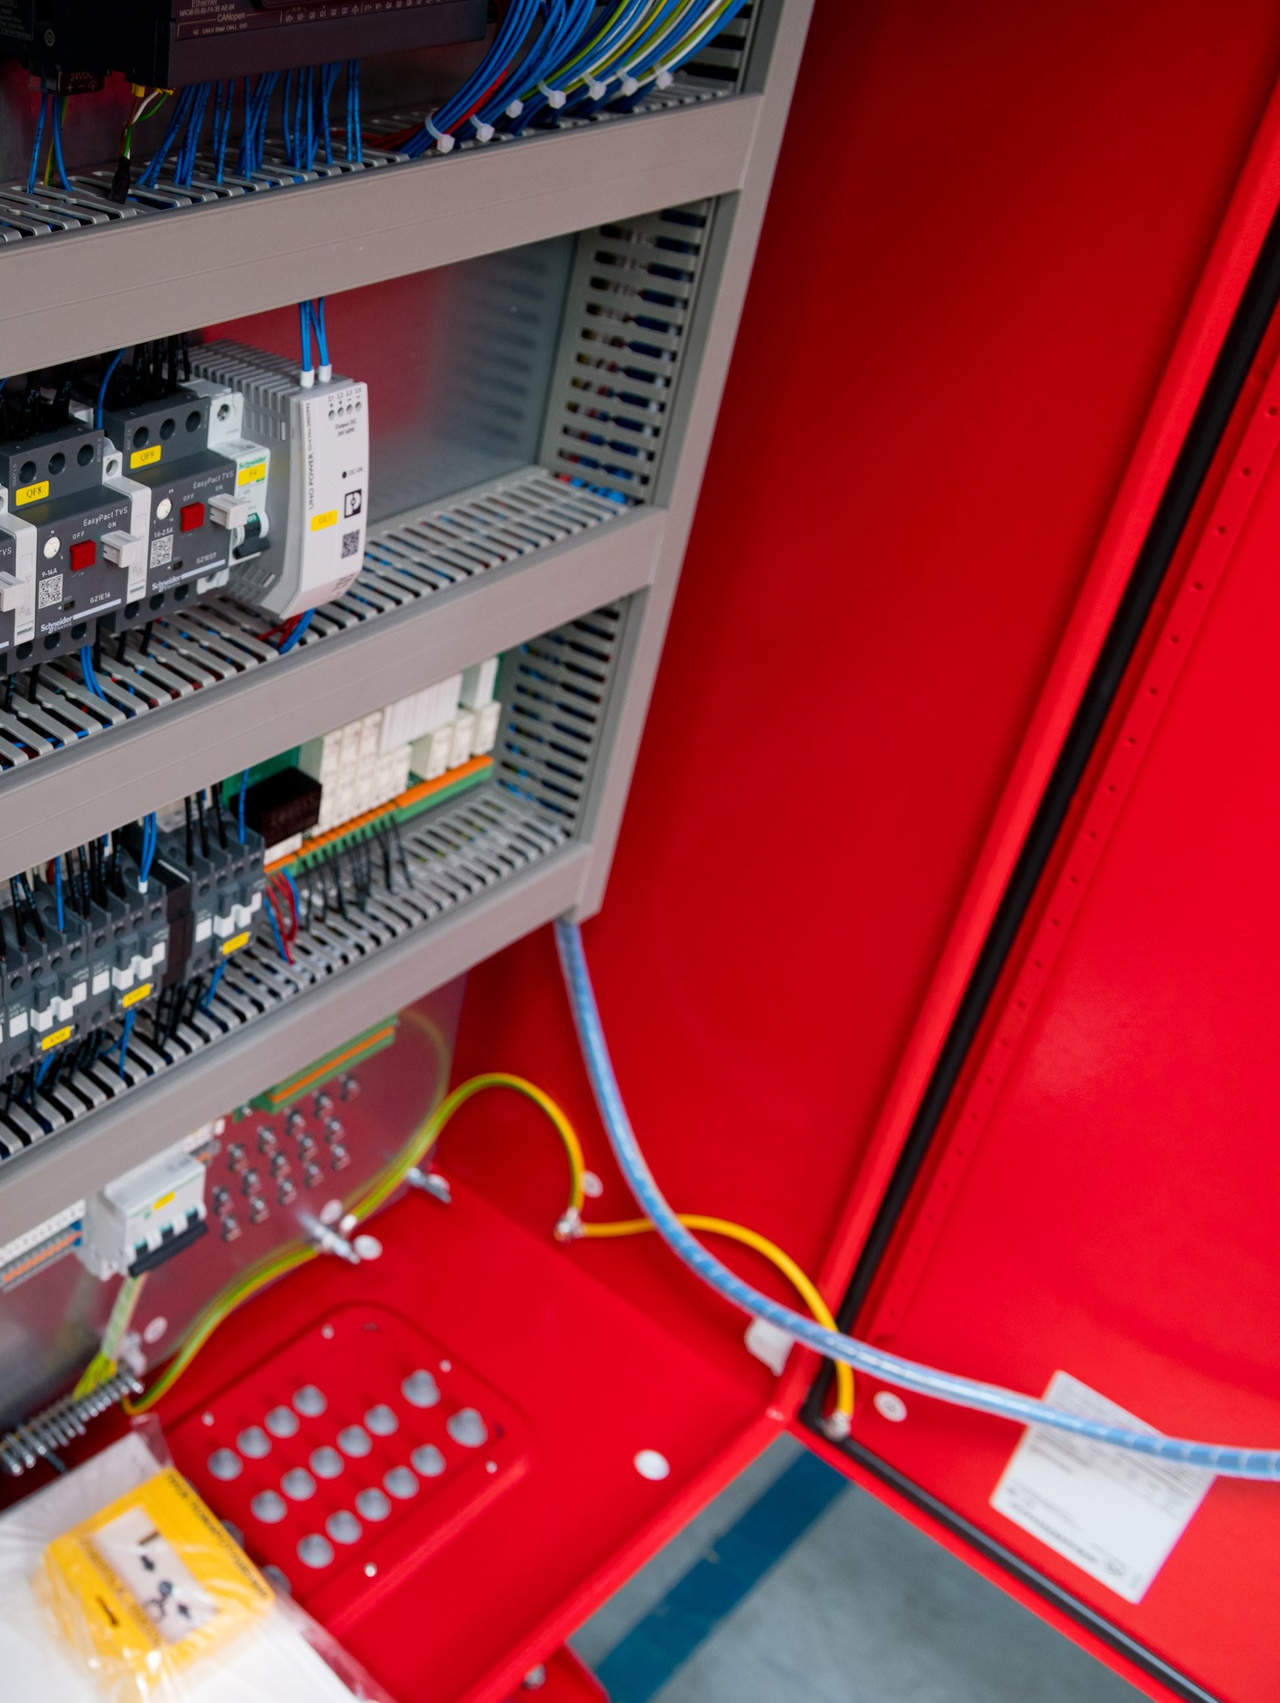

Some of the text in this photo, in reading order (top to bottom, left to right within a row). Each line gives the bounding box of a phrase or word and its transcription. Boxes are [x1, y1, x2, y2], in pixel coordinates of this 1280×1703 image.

[217, 12, 246, 23] CANopen
[139, 450, 155, 463] QF9
[307, 452, 315, 487] POWER
[192, 470, 235, 490] EasyPact TVS
[25, 485, 43, 499] QF8
[182, 484, 224, 502] OFF ON
[307, 487, 315, 511] UNO
[83, 506, 129, 527] EasyPact TVS
[72, 521, 117, 540] OFF ON
[41, 567, 58, 578] 9-14A
[151, 574, 183, 592] Schneider
[89, 591, 111, 604] GZ1E16
[39, 614, 74, 634] Schneider
